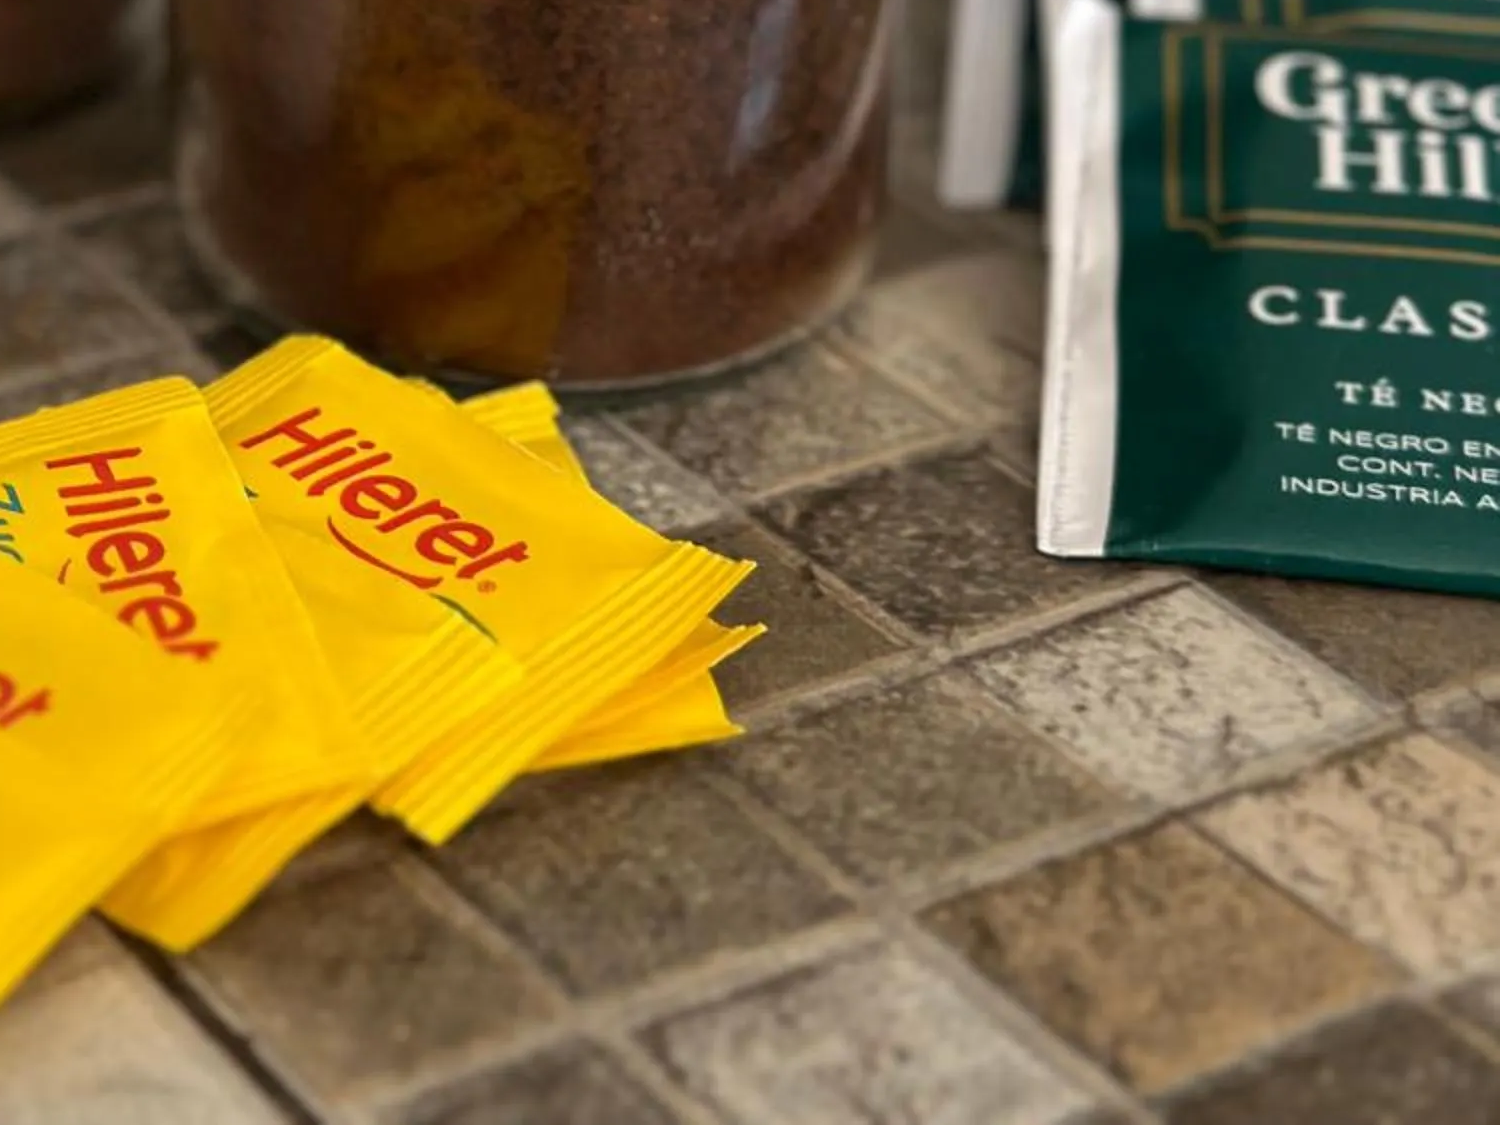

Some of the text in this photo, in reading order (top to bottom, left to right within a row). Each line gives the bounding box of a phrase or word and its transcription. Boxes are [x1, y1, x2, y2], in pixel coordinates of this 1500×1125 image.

[1314, 126, 1500, 201] Hil
[1249, 285, 1491, 340] CLAS
[1335, 377, 1500, 416] TÉ NE
[1329, 428, 1449, 455] NEGRO
[1337, 455, 1443, 479] CONT.
[239, 407, 529, 579] Hileret
[1281, 476, 1466, 507] INDUSTRIA
[46, 447, 220, 661] Hileret
